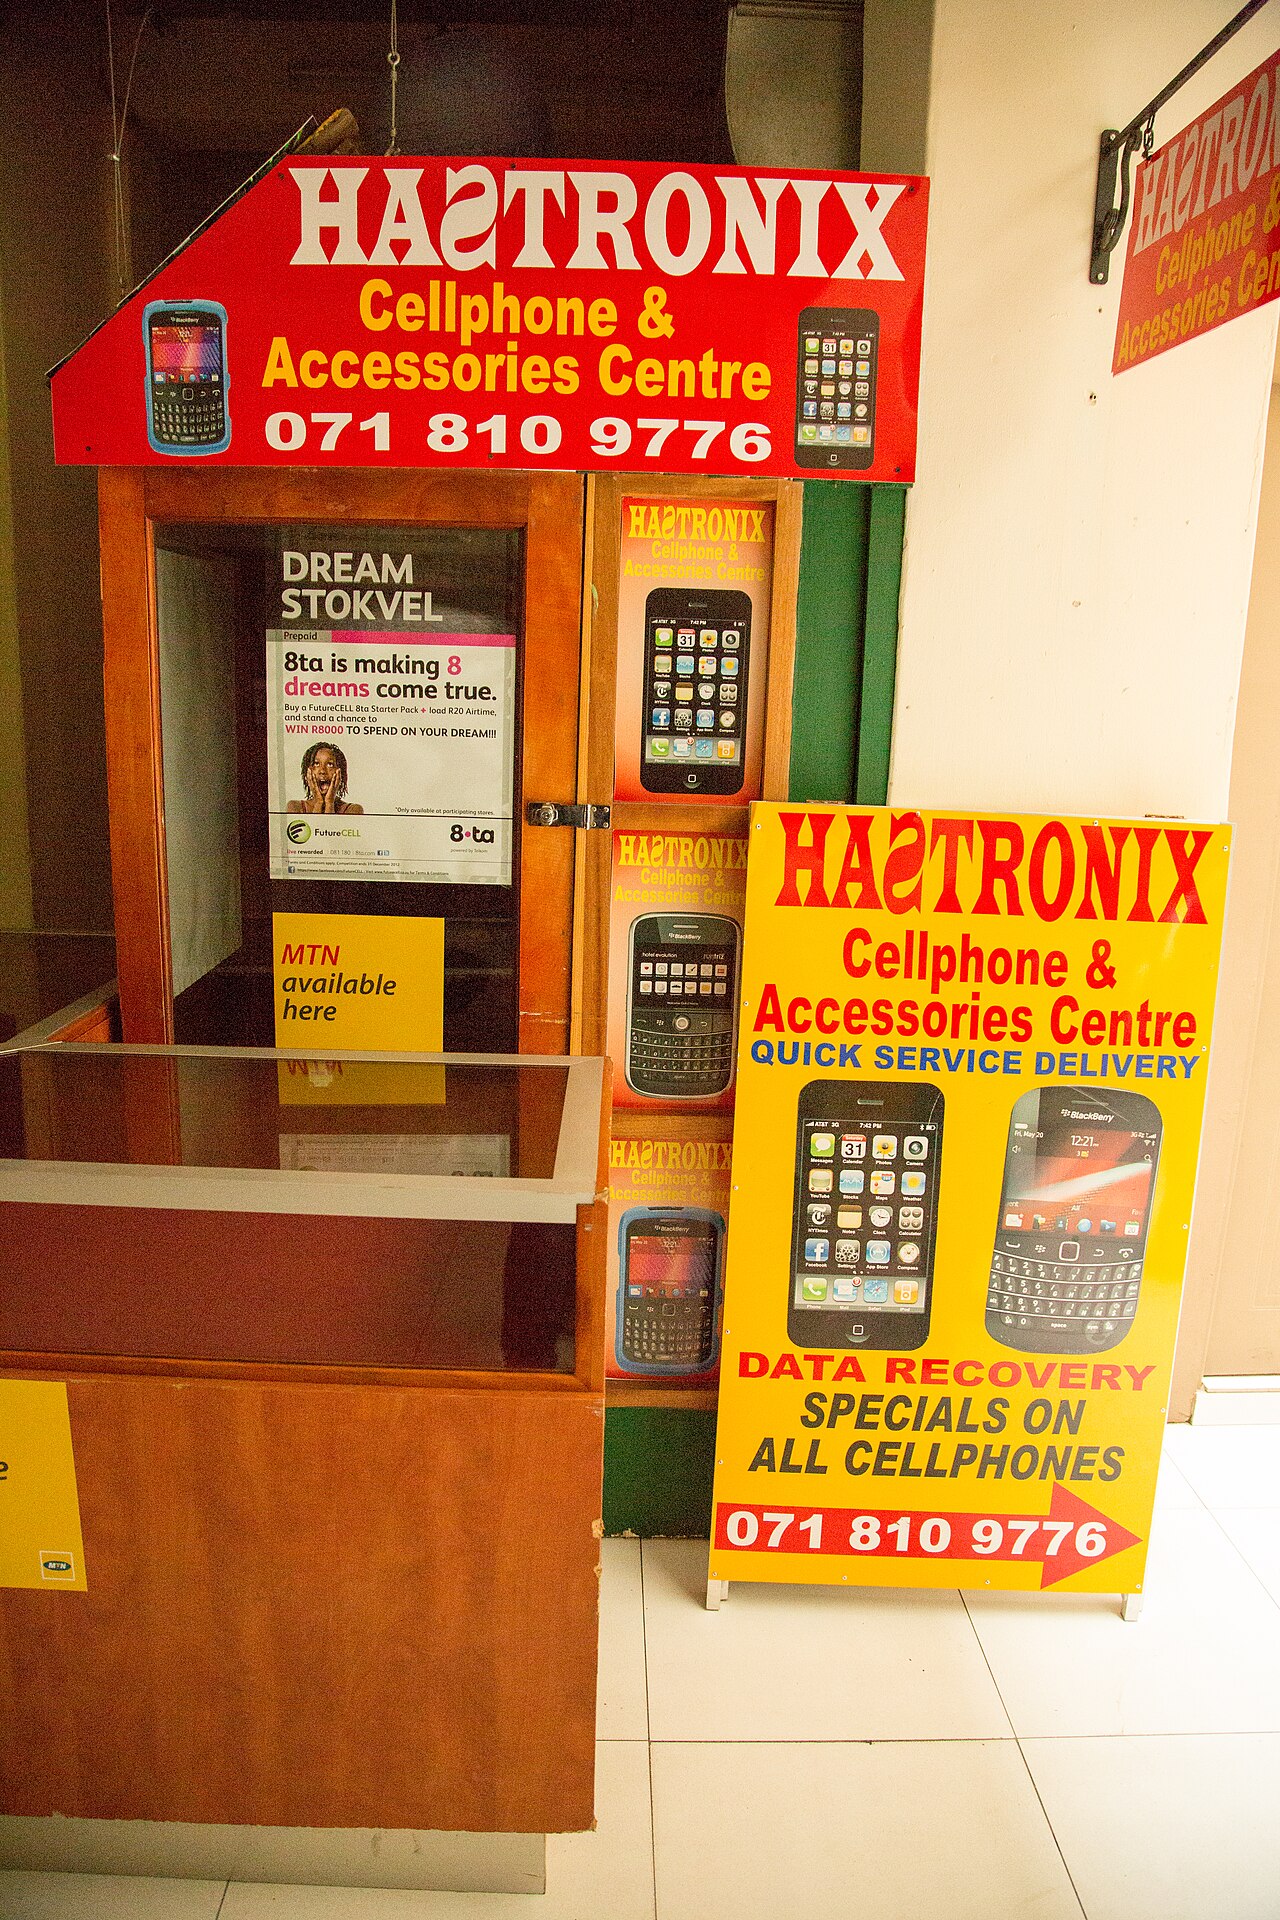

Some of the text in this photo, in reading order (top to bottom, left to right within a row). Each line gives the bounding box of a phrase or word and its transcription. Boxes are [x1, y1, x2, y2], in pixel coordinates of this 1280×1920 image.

[288, 164, 907, 281] HASTRONIX
[1155, 203, 1257, 296] Cellphone
[359, 279, 675, 346] Cellphone &
[1117, 275, 1232, 367] Accessories
[261, 337, 579, 394] Accessories
[599, 344, 771, 400] Centre
[265, 412, 390, 451] 071
[427, 413, 562, 454] 810
[589, 417, 772, 462] 9776
[628, 505, 766, 543] HASTRONIX
[652, 540, 739, 562] Cellphone &
[283, 551, 413, 584] DREAM
[624, 559, 765, 581] Accessories Centre
[281, 588, 443, 622] STOKVEL
[283, 631, 318, 642] Prepaid
[680, 635, 693, 646] 31
[284, 651, 462, 680] 8ta is making 8
[284, 676, 497, 701] dreams come true.
[284, 704, 300, 713] Buy
[309, 704, 353, 712] FutureCELL
[372, 705, 398, 713] Starter
[400, 706, 419, 714] Pack
[465, 708, 497, 717] Airtime,
[284, 714, 300, 722] and
[303, 714, 326, 722] stand
[336, 714, 366, 723] chance
[285, 724, 497, 739] WIN R8000 TO SPEND ON YOUR DREAM!!!
[315, 828, 361, 837] FutureCELL
[618, 835, 749, 868] HASTRONIX
[641, 867, 710, 888] Cellphone
[775, 811, 1214, 925] HASTRONIX
[615, 885, 699, 904] Accessories
[281, 943, 340, 966] MTN
[843, 927, 1117, 994] Cellphone &
[282, 973, 397, 995] available
[282, 999, 337, 1021] here
[753, 984, 1033, 1042] Accessories
[1050, 994, 1196, 1048] Centre
[751, 1039, 862, 1068] QUICK
[875, 1045, 1023, 1075] SERVICE
[1035, 1051, 1199, 1080] DELIVERY
[1070, 1111, 1114, 1123] BlackBerry
[844, 1143, 862, 1156] 31
[631, 1169, 696, 1188] Cellphone
[739, 1351, 1157, 1391] DATA RECOVERY
[800, 1391, 1087, 1435] SPECIALS ON
[748, 1437, 1125, 1482] ALL CELLPHONES
[726, 1511, 1107, 1557] 071 810 9776
